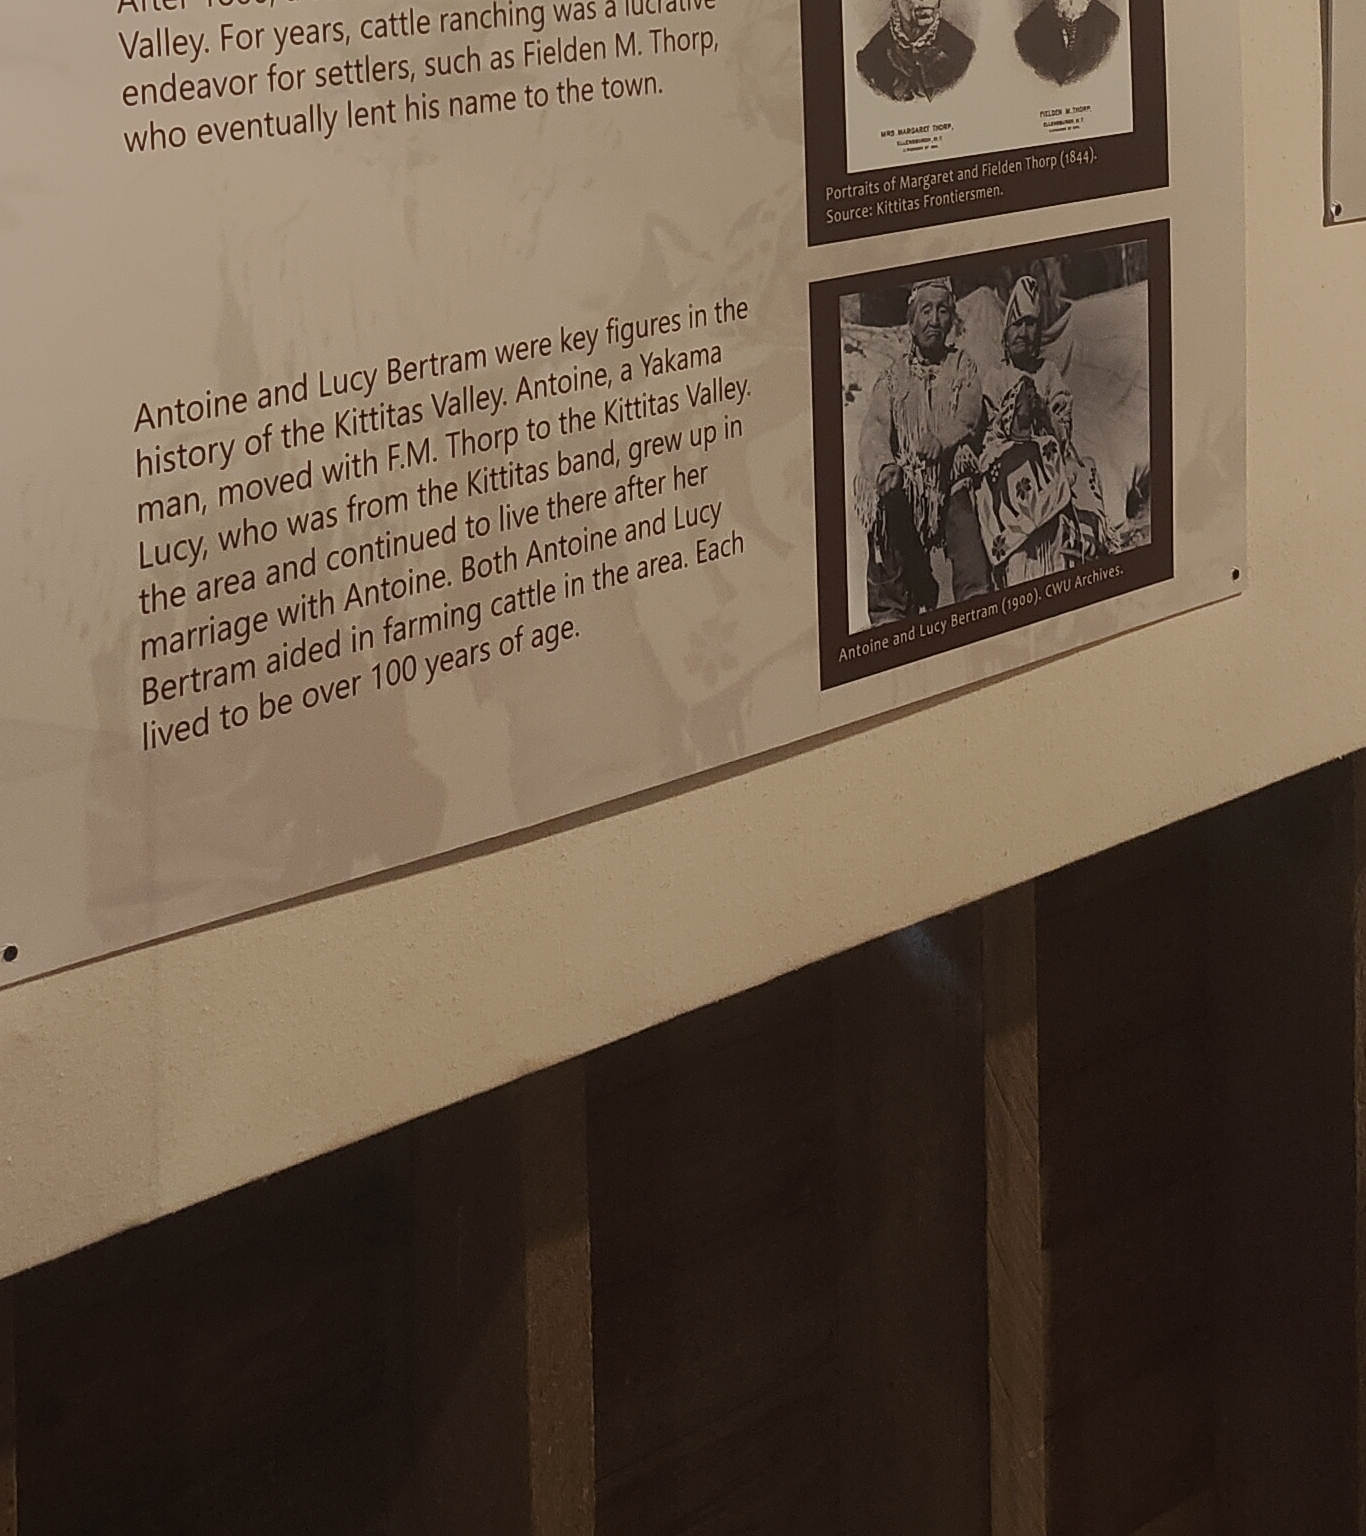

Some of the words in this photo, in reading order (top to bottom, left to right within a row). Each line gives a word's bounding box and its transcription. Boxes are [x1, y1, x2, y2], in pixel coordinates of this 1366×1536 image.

[117, 25, 210, 64] Valley.
[219, 22, 265, 52] For
[272, 20, 351, 56] years,
[359, 6, 431, 40] cattle
[439, 0, 545, 33] ranching
[551, 0, 597, 23] was
[121, 71, 259, 107] endeavor
[265, 61, 306, 93] for
[314, 53, 416, 88] settlers,
[423, 43, 481, 77] such
[489, 48, 515, 71] as
[523, 34, 607, 68] Fielden
[614, 30, 643, 58] M.
[652, 25, 719, 57] Thorp,
[122, 119, 186, 153] who
[196, 101, 338, 145] eventually
[346, 98, 397, 129] lent
[404, 91, 440, 122] his
[448, 90, 517, 117] name
[523, 83, 549, 109] to
[554, 75, 594, 105] the
[599, 74, 663, 100] town.
[824, 179, 880, 201] Portraits
[882, 174, 897, 192] of
[898, 168, 954, 191] Margaret
[956, 162, 979, 181] and
[980, 158, 1023, 177] Fielden
[1023, 154, 1058, 171] Thorp
[1059, 144, 1098, 169] (1844).
[825, 205, 873, 224] Source:
[875, 196, 920, 216] Kittitas
[922, 184, 1004, 208] Frontiersmen.
[132, 388, 248, 433] Antoine
[256, 370, 308, 410] and
[318, 366, 378, 399] Lucy
[386, 347, 487, 385] Bertram
[493, 336, 552, 365] were
[559, 324, 599, 357] key
[604, 312, 682, 350] figures
[689, 303, 707, 330] in
[712, 295, 748, 324] the
[837, 636, 889, 663] Antoine
[891, 624, 916, 646] and
[918, 618, 947, 637] Lucy
[949, 602, 999, 628] Bertram
[1000, 586, 1042, 615] (1900).
[1044, 577, 1071, 598] CWU
[1073, 564, 1124, 589] Archives.
